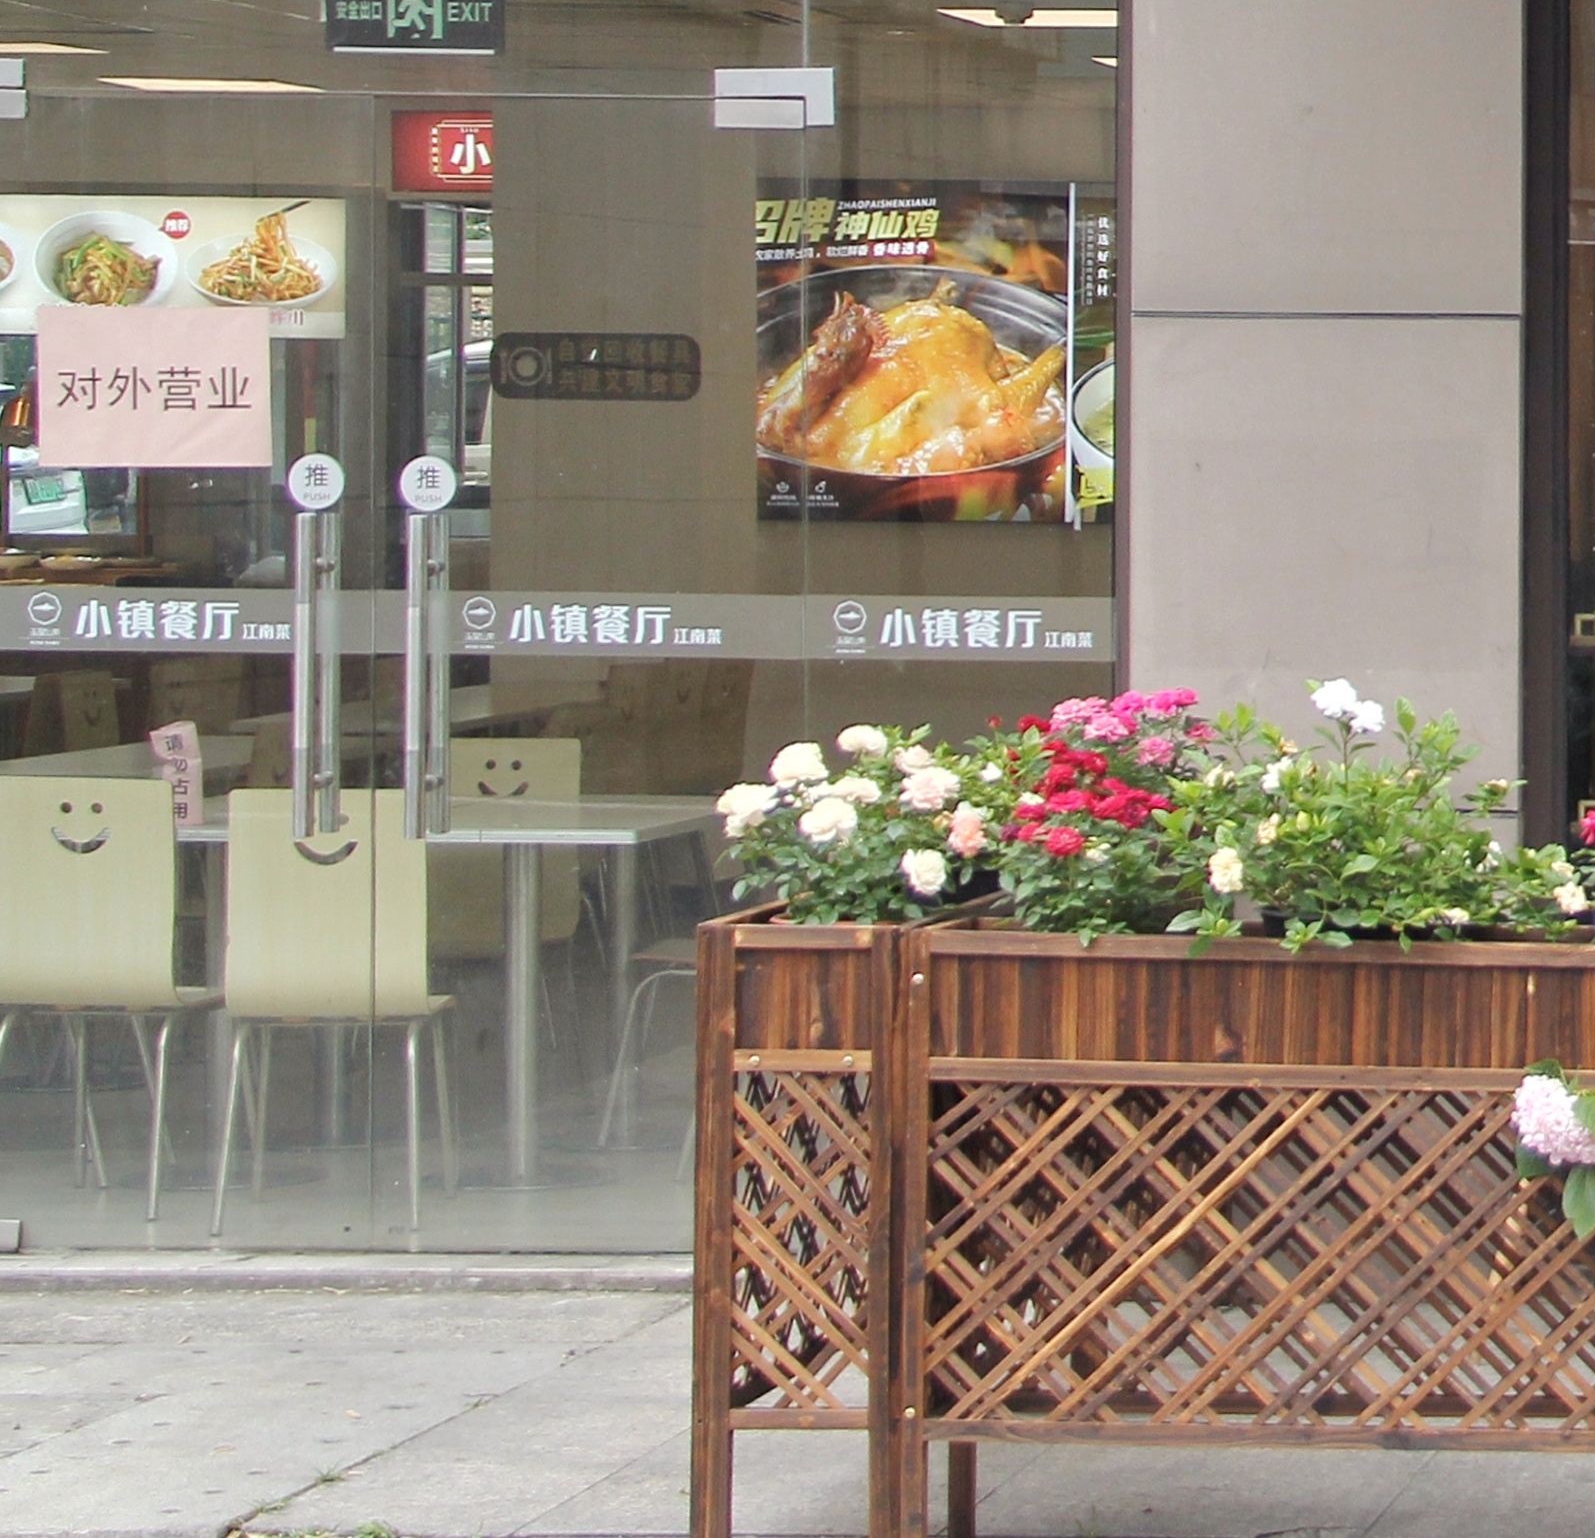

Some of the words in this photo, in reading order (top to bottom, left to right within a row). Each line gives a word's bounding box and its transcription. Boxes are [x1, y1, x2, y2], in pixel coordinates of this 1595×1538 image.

[335, 0, 383, 21] 安全出口
[447, 2, 493, 22] EXIT
[837, 198, 937, 210] ZHAOPAISHENXIANJI
[834, 209, 940, 242] 神仙鸡
[56, 367, 253, 412] 对外营业
[305, 463, 329, 488] 推
[417, 466, 441, 490] 推
[303, 491, 331, 501] PUSH
[415, 494, 442, 503] PUSH
[75, 600, 239, 641] 小镇餐厅
[242, 623, 291, 641] 江南菜
[510, 603, 671, 644] 小镇餐厅
[673, 627, 722, 645] 江南菜
[880, 608, 1042, 649] 小镇餐厅
[1045, 631, 1093, 649] 江南菜
